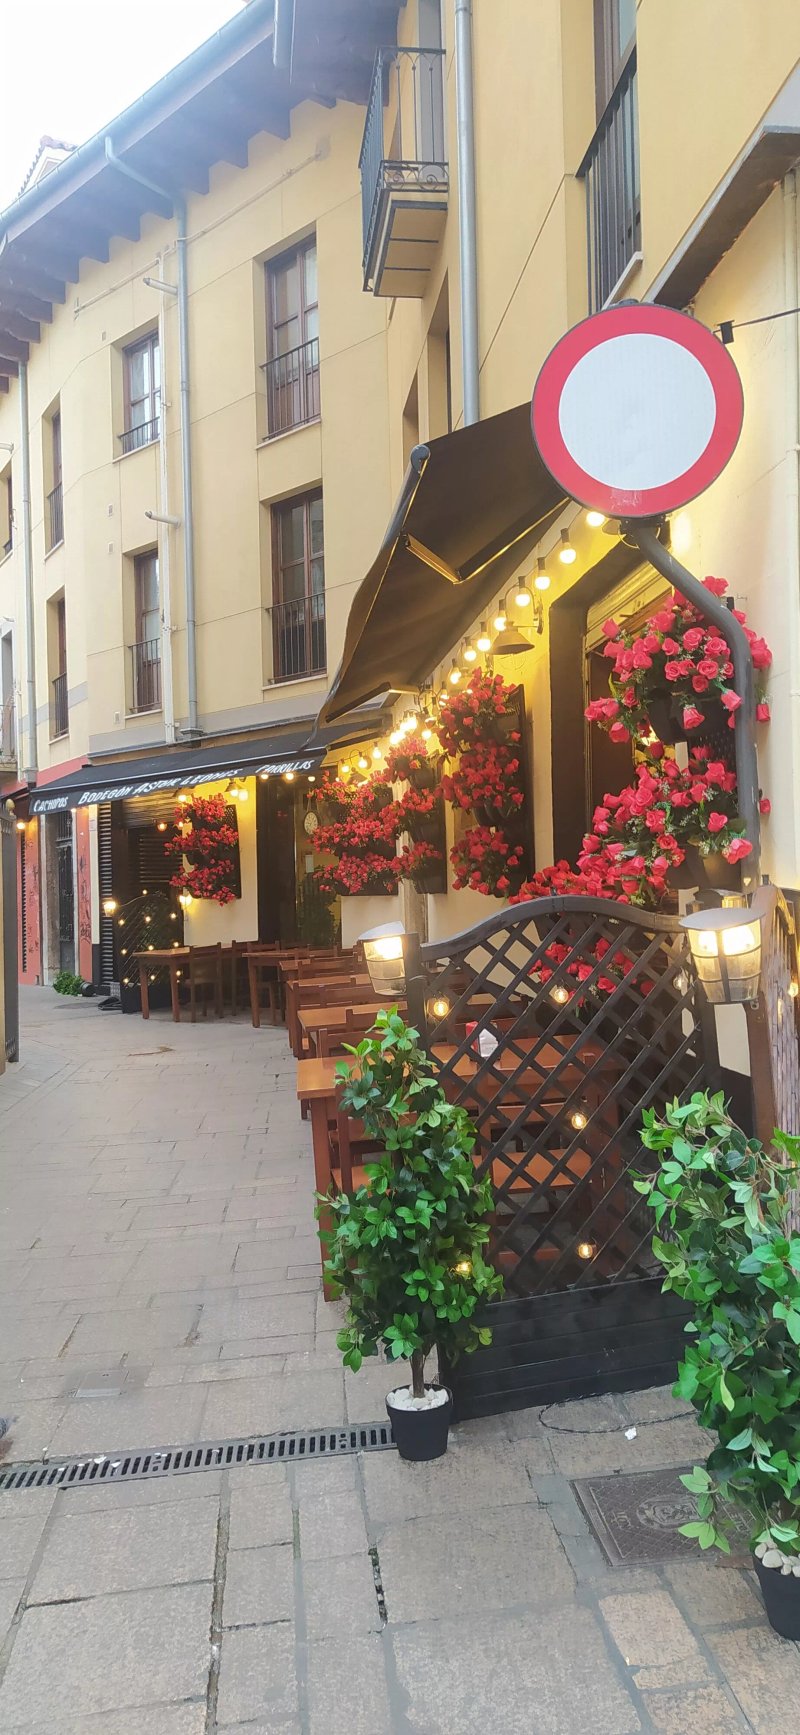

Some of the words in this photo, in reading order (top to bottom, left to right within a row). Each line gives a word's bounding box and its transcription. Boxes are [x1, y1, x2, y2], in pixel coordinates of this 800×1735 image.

[255, 760, 315, 774] PARRILLAS
[78, 785, 133, 805] BODEGÓN
[132, 778, 182, 795] ASTUR
[33, 796, 69, 812] CACHOPOS
